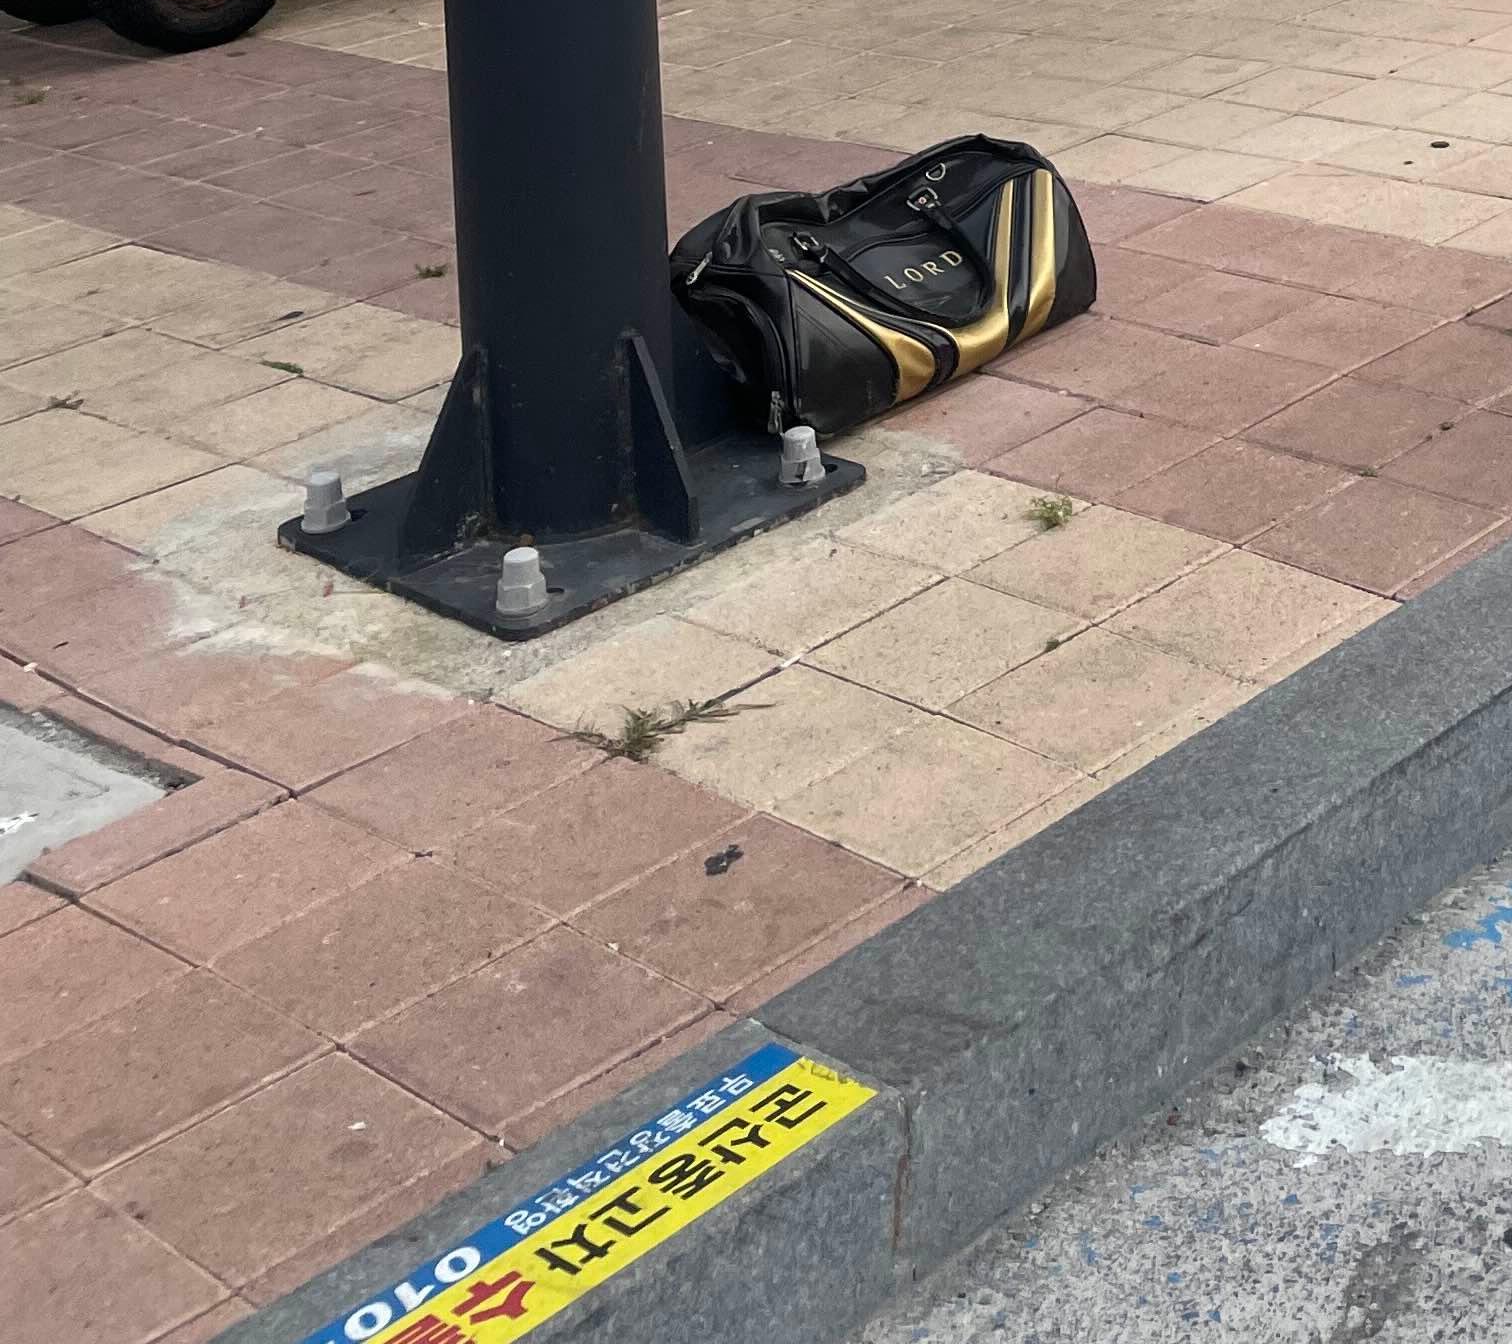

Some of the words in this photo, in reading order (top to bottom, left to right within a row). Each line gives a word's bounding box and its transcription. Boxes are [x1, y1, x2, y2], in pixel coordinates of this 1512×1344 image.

[884, 250, 964, 290] LORD
[504, 1073, 755, 1236] 무료출장견적환영
[535, 1083, 828, 1276] 군산중고차
[343, 1246, 482, 1341] 010
